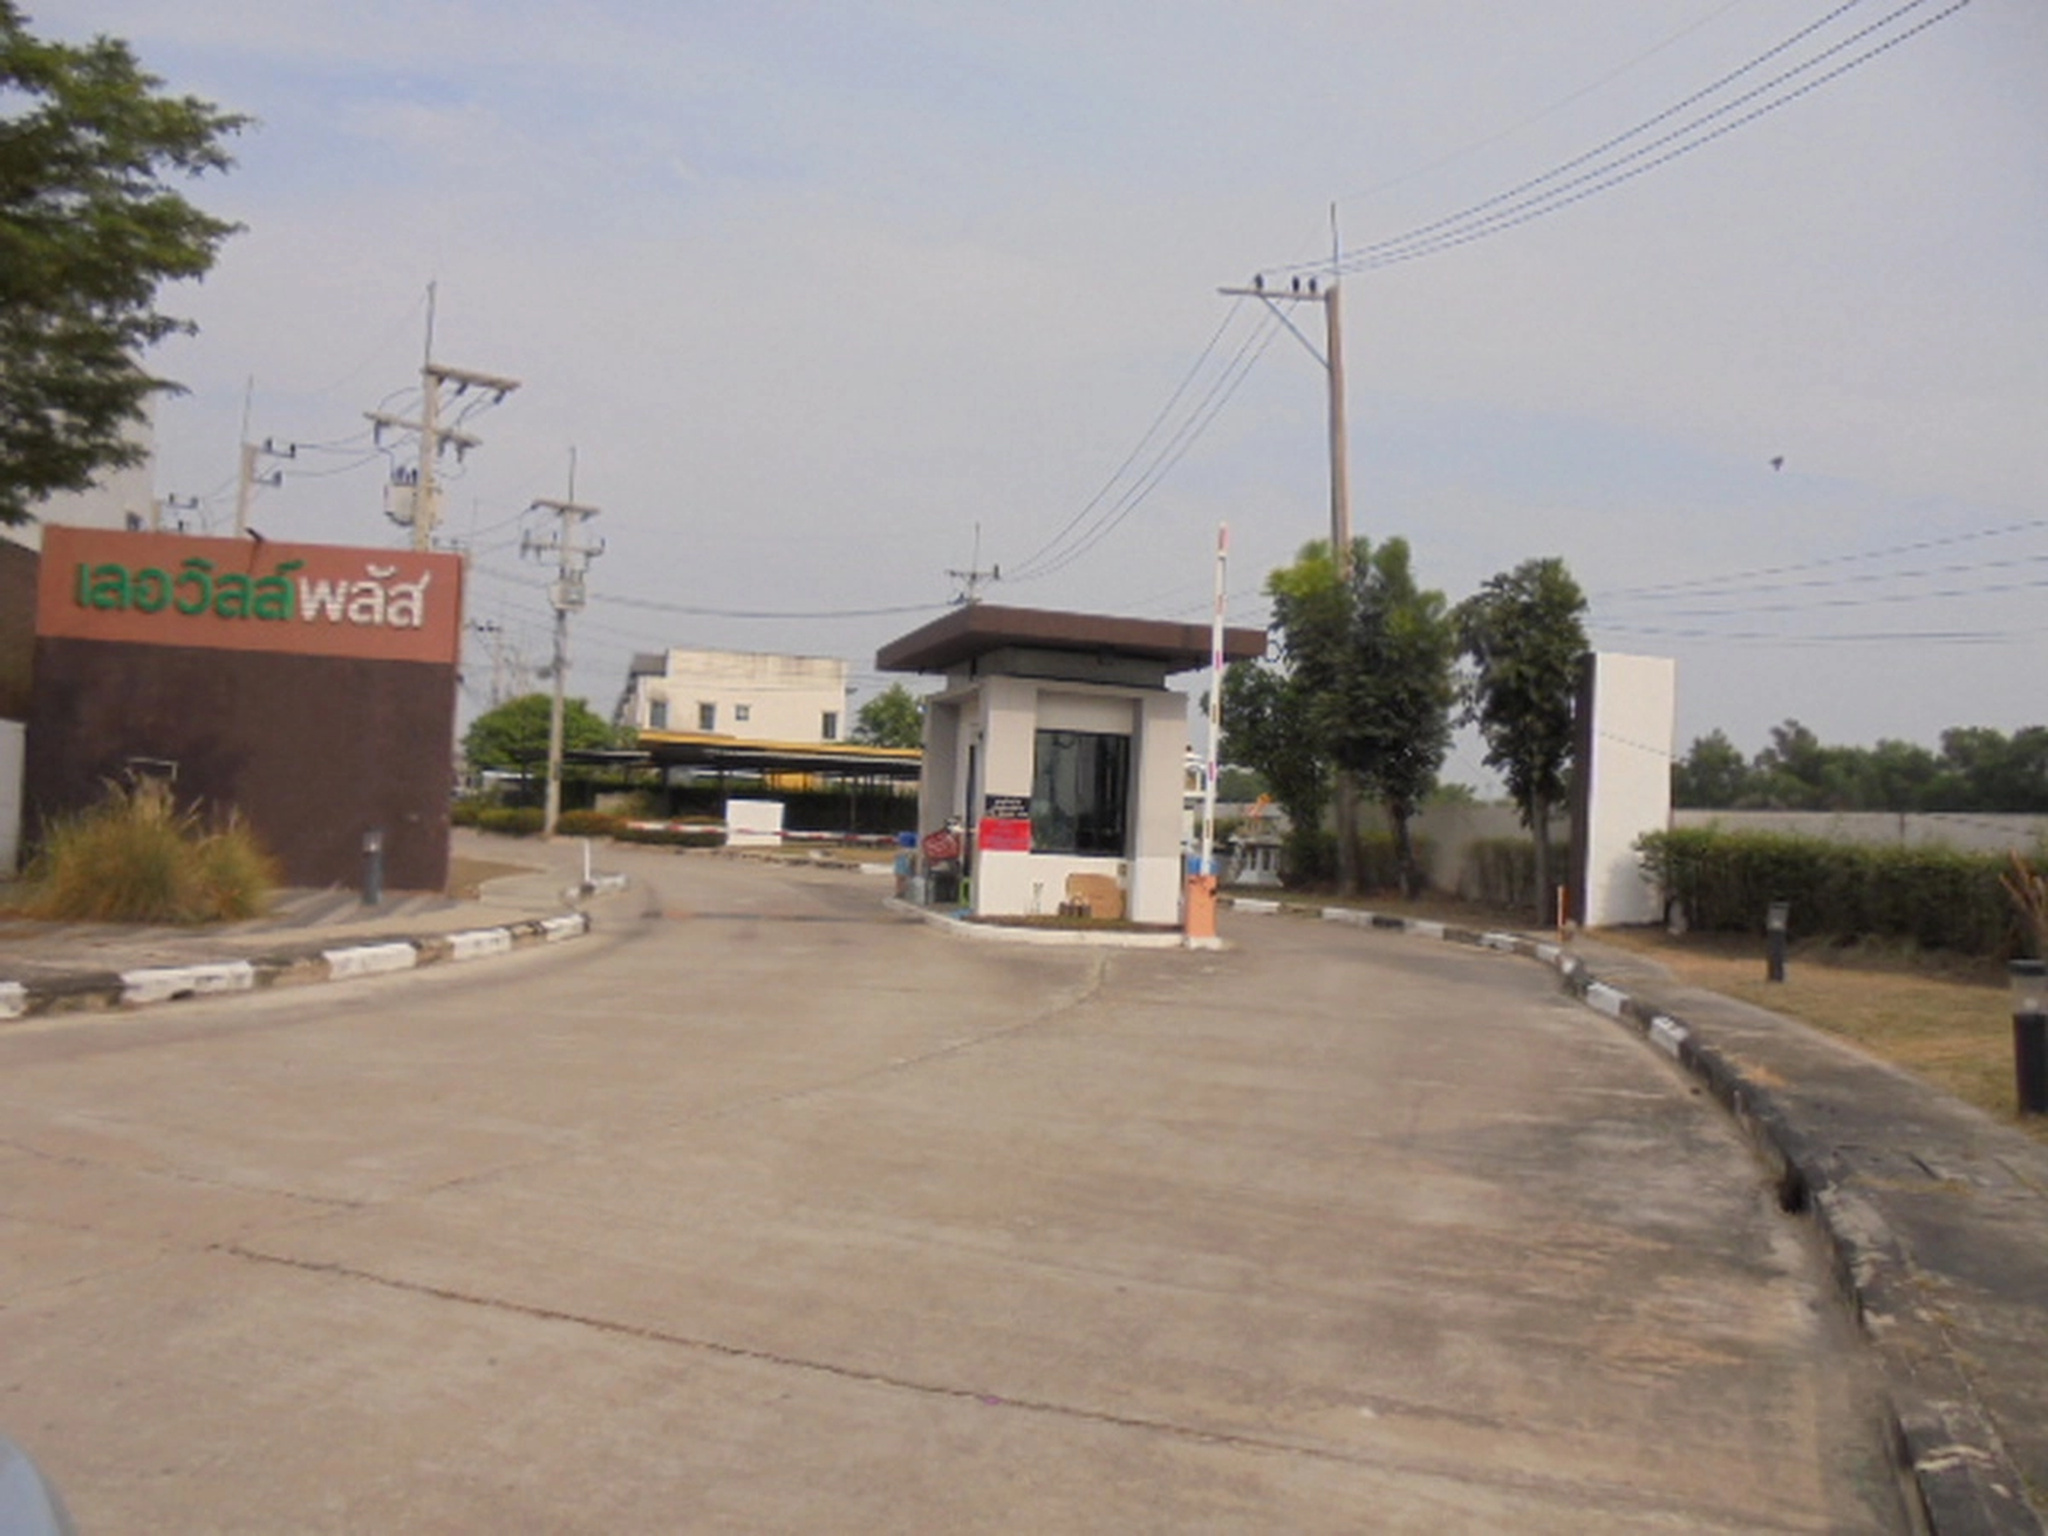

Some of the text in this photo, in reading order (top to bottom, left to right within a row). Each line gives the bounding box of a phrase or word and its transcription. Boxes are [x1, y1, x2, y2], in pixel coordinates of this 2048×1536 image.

[75, 557, 431, 628] เลอวิลล์พลัส
